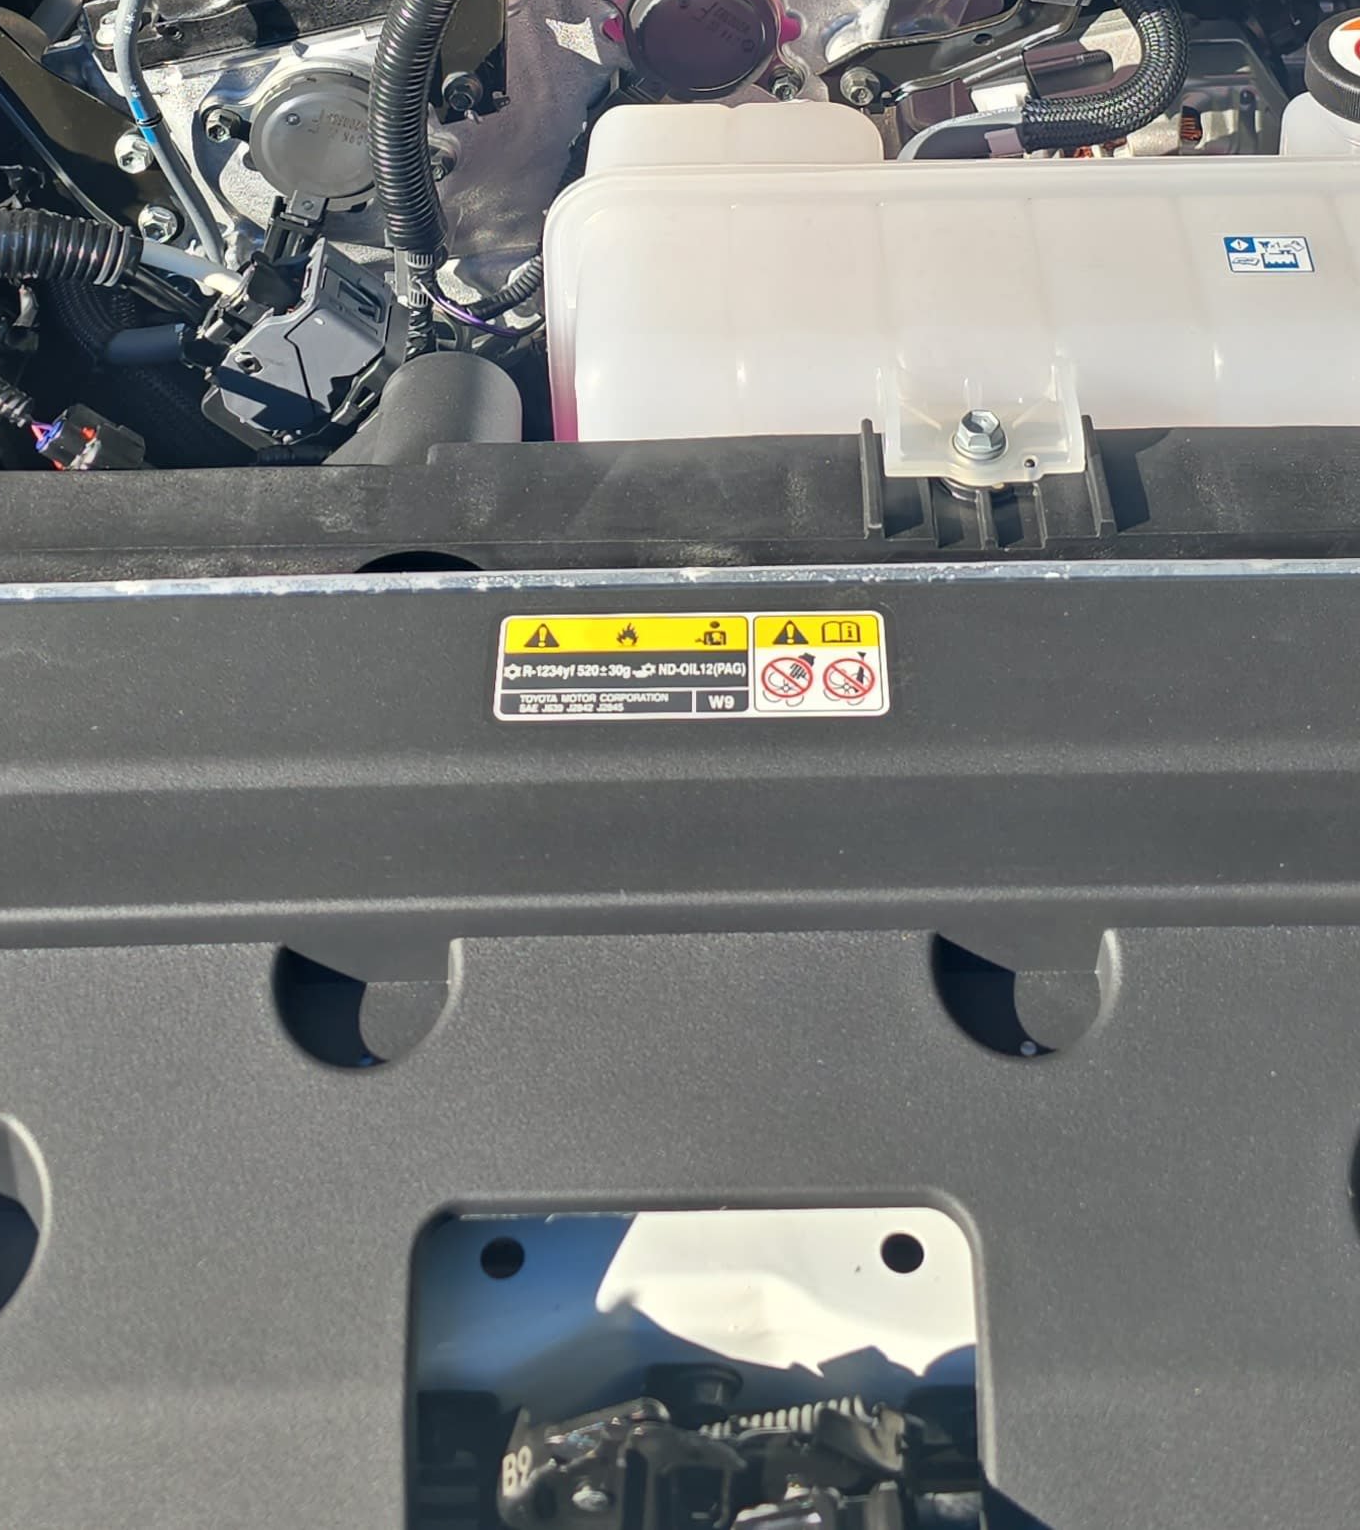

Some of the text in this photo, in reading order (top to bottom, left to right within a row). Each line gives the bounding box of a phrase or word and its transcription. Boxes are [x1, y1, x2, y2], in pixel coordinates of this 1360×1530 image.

[522, 662, 746, 680] R-1234yf 520±30g ND-OIL12(PAG)
[520, 692, 669, 703] TOYOTA MOTOR CORPORATION
[708, 695, 735, 709] W9
